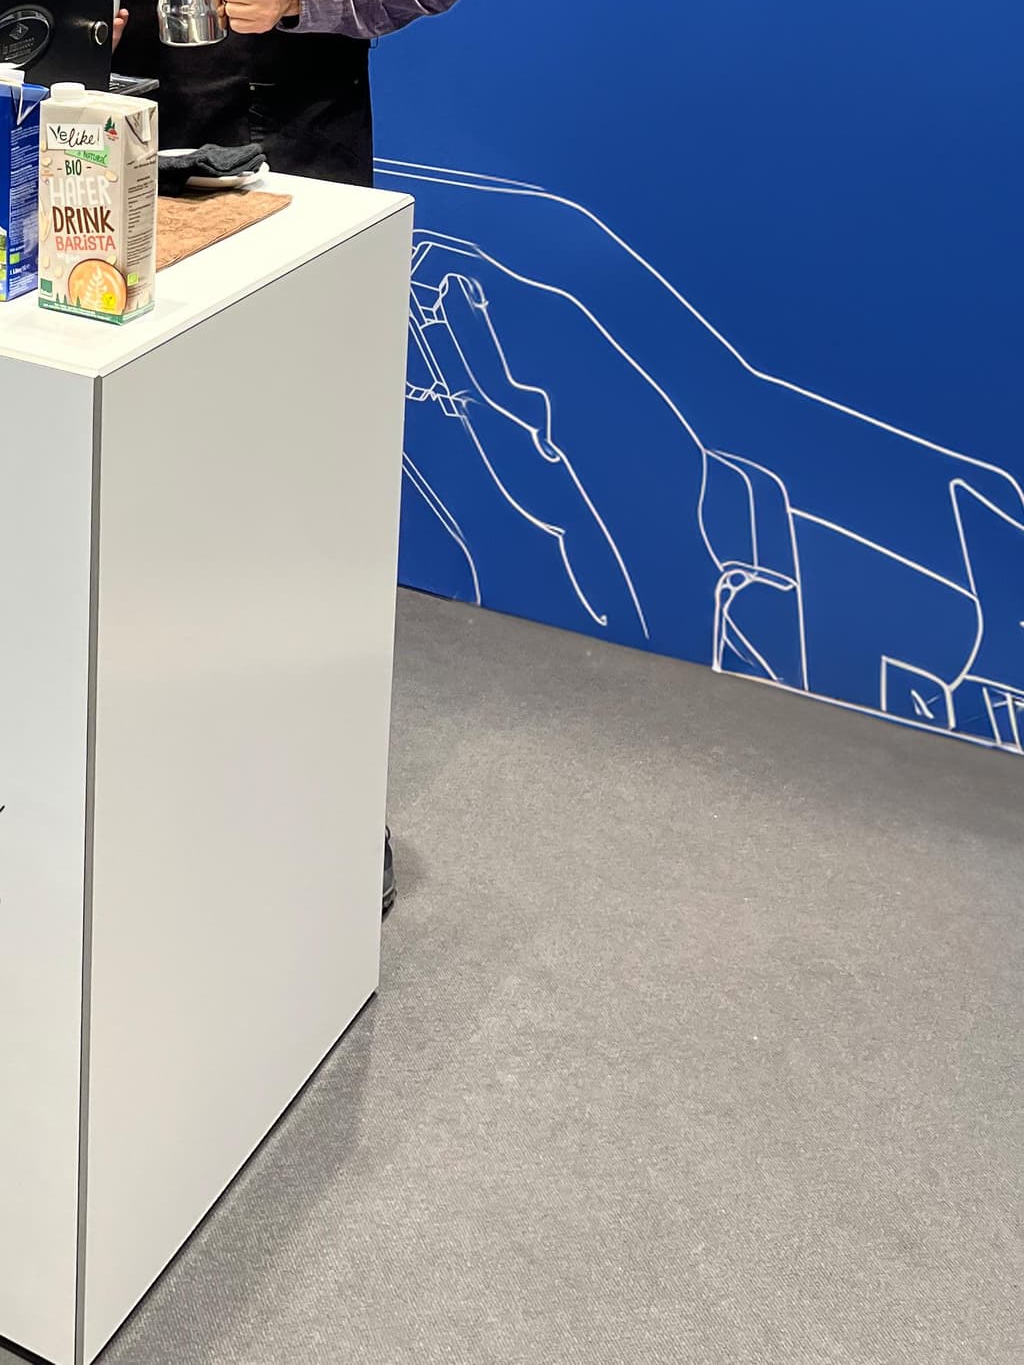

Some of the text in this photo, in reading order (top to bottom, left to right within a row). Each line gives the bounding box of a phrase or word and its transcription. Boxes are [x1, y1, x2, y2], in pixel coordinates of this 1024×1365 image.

[65, 159, 82, 176] BIO
[49, 177, 113, 207] HAFER
[52, 205, 115, 234] DRINK
